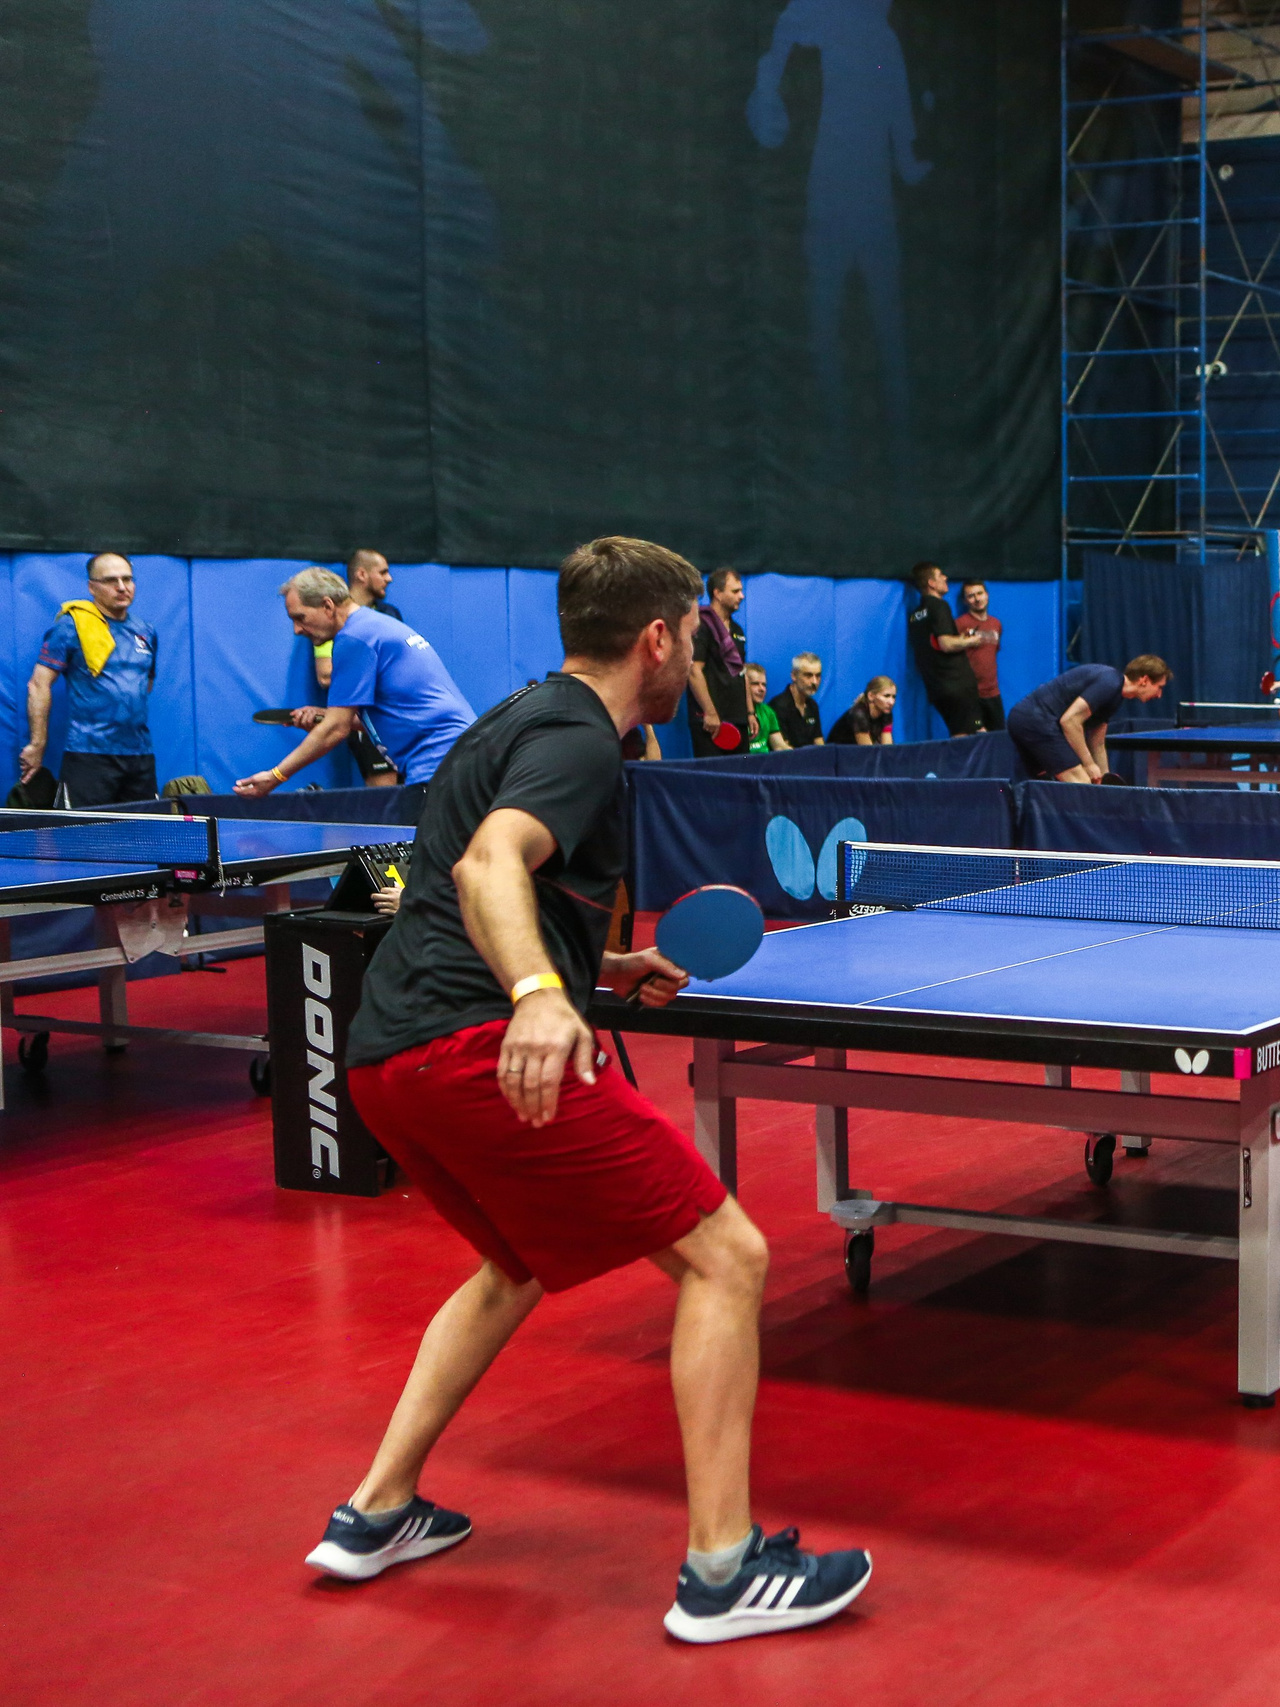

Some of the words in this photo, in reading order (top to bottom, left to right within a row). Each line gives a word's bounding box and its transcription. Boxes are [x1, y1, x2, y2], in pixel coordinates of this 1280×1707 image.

[100, 890, 136, 902] Centrefold
[136, 888, 145, 898] 25
[302, 942, 340, 1180] DONIC
